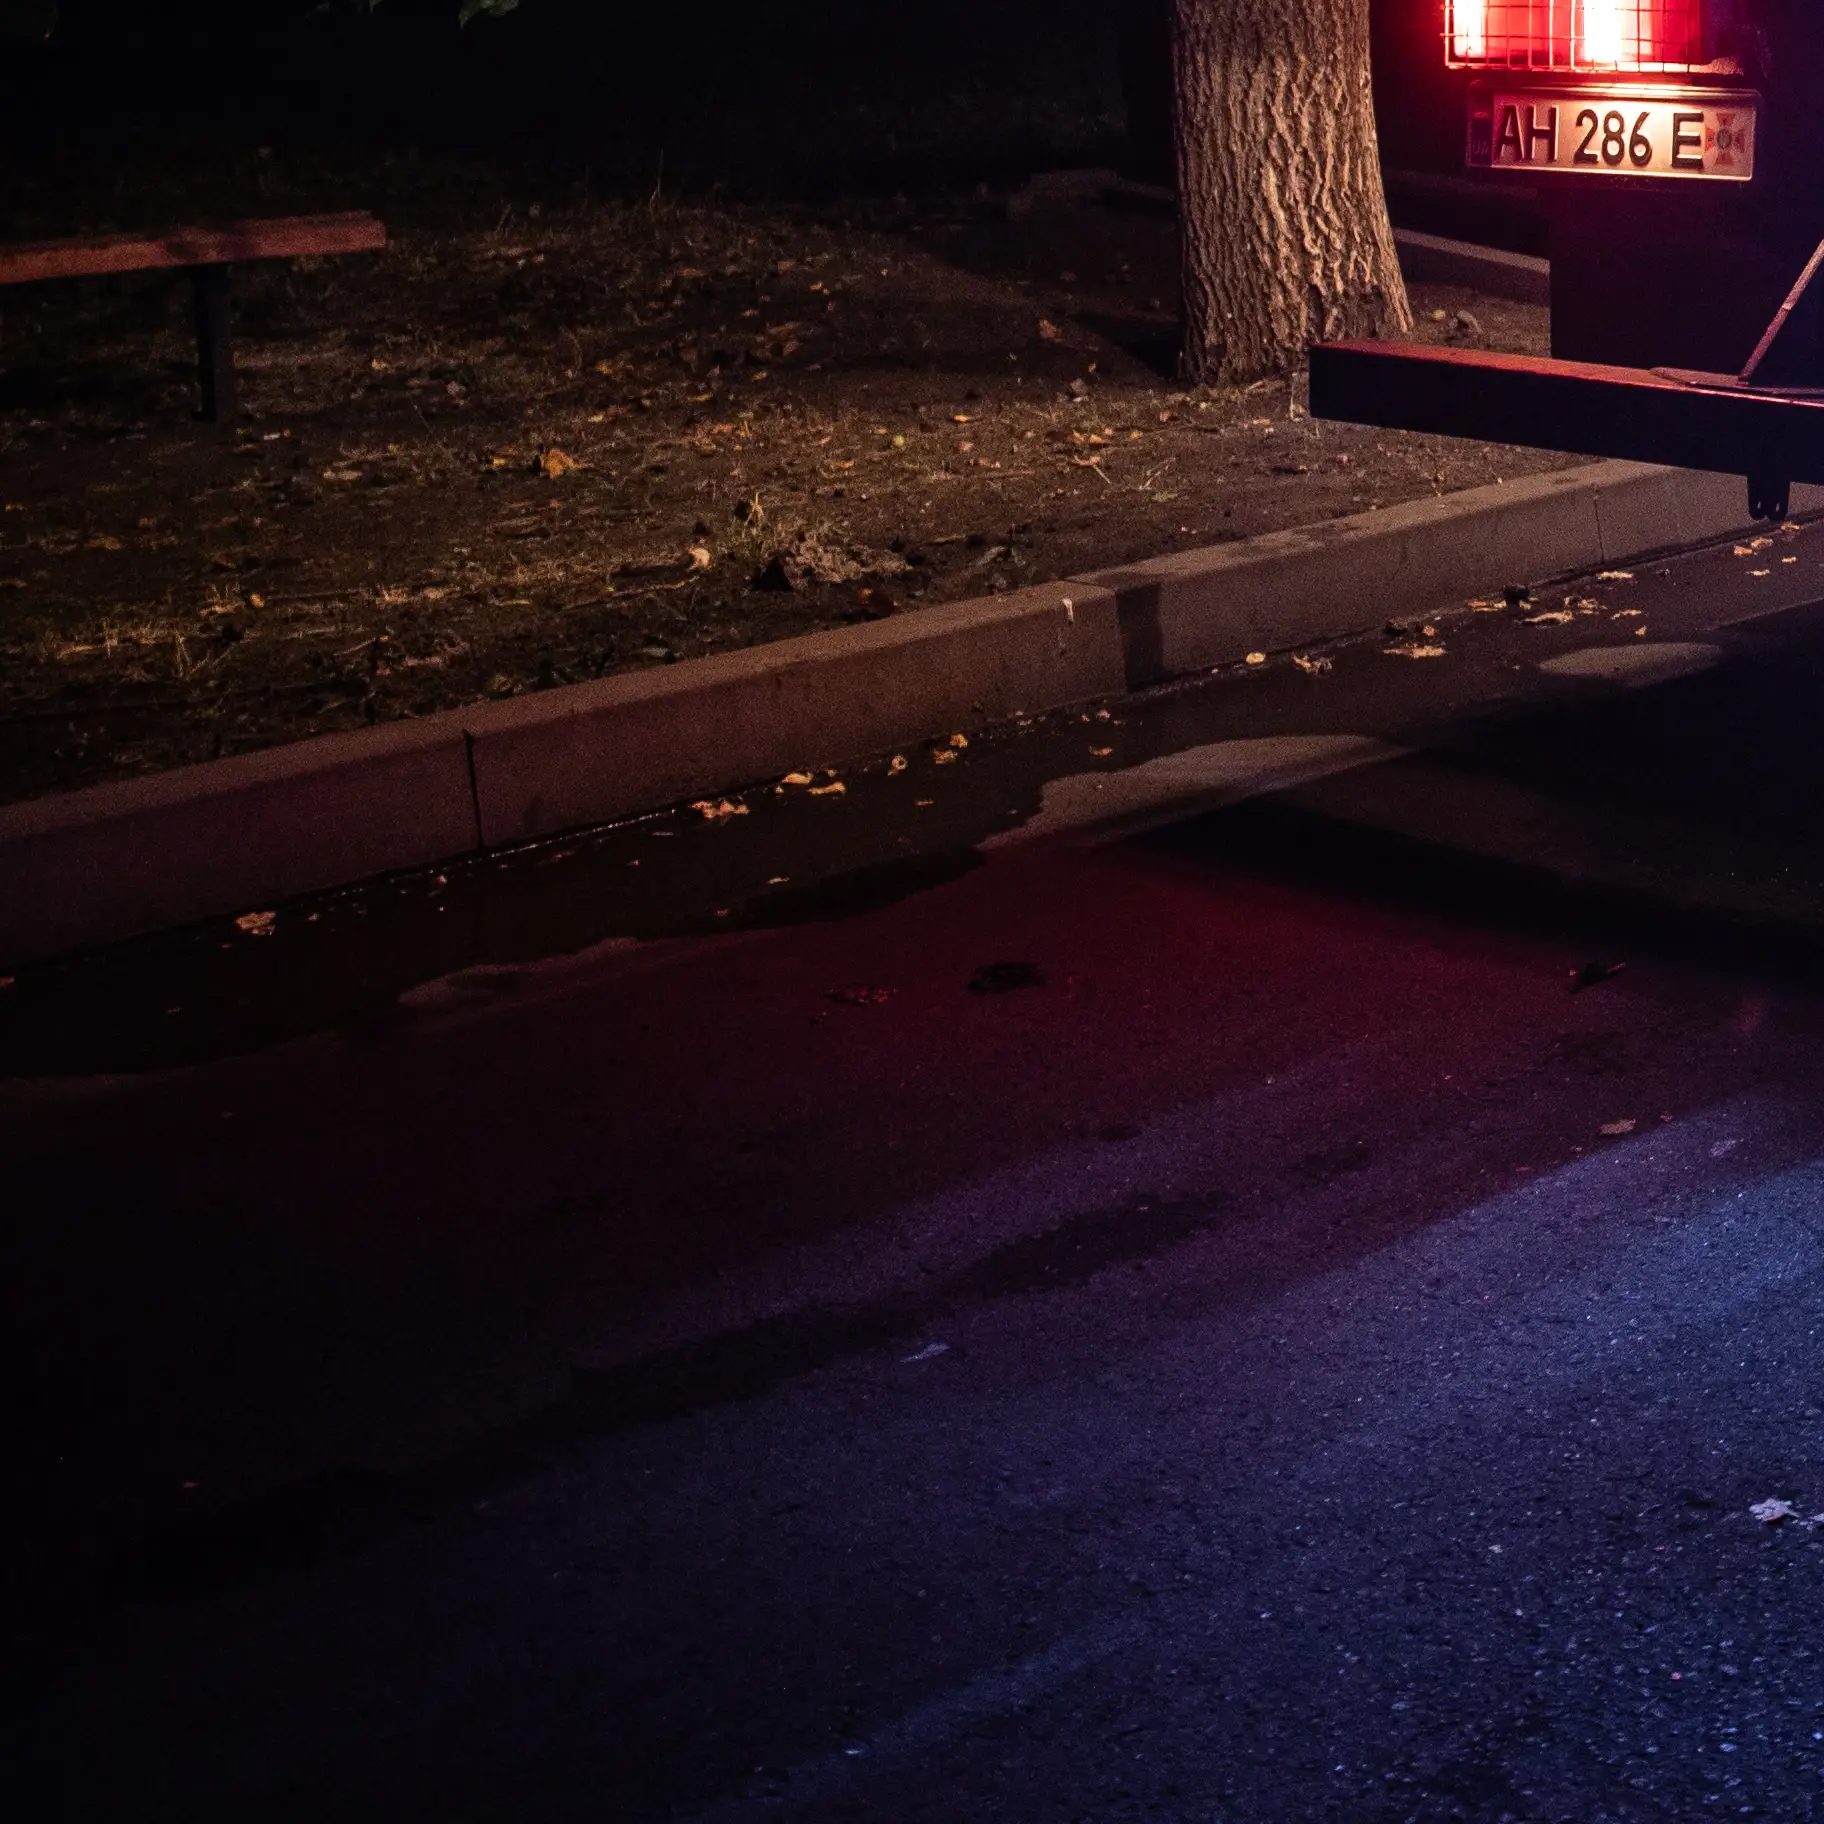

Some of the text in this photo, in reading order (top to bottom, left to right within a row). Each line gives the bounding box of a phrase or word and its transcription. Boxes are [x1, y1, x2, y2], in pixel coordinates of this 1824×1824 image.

[1500, 105, 1704, 169] AH 286 E
